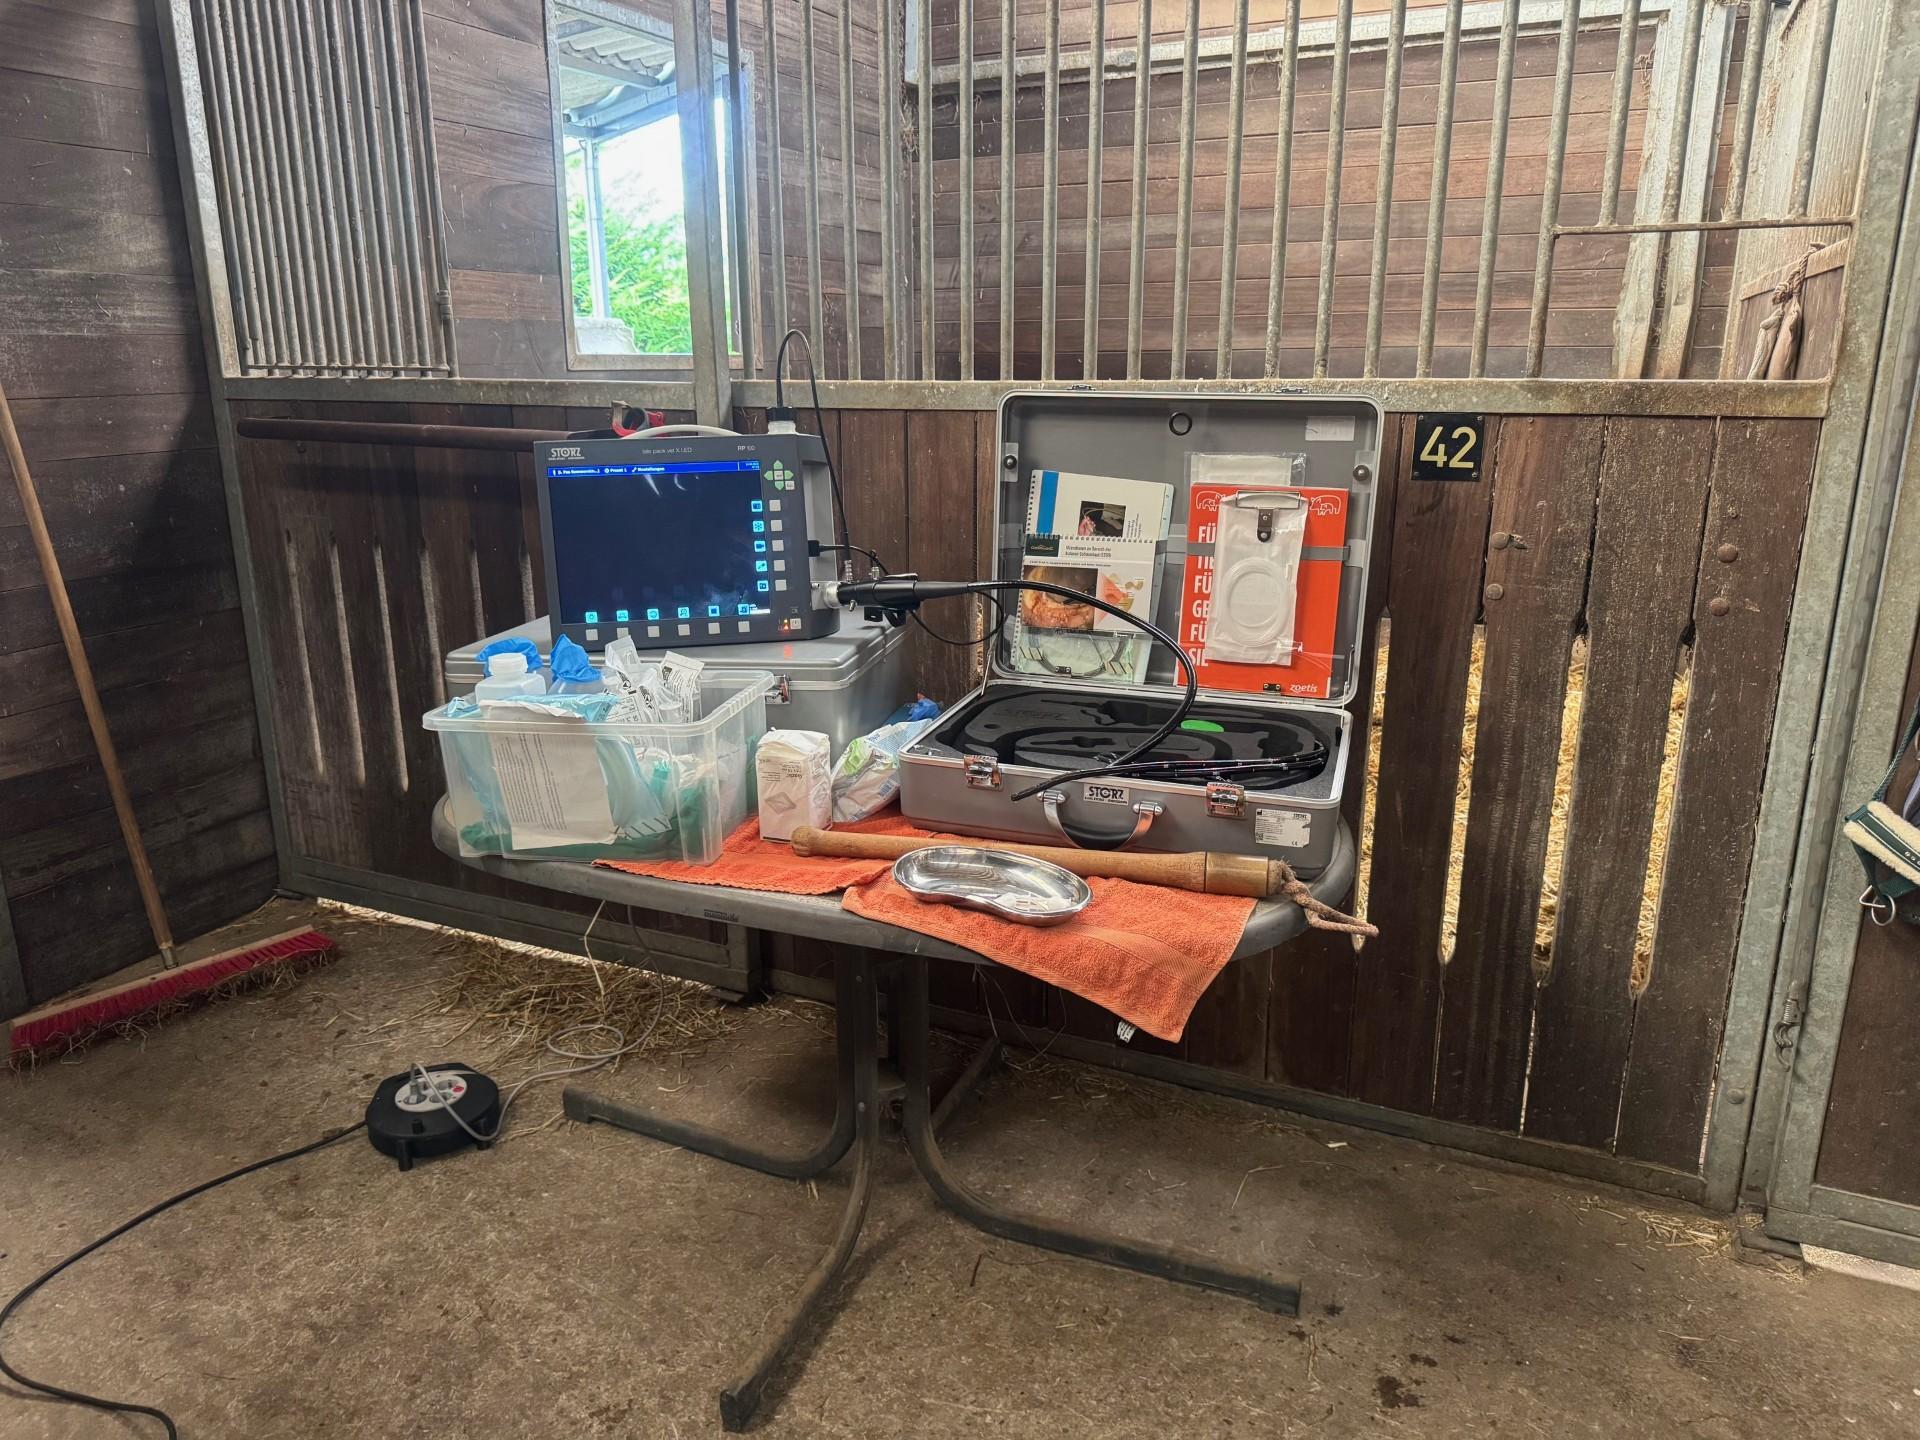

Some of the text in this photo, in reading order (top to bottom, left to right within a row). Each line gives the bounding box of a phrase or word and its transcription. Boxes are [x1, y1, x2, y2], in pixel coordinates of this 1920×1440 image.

[551, 447, 582, 458] STORZ
[1420, 426, 1476, 468] 42
[1198, 522, 1217, 544] FÜ
[1194, 572, 1212, 594] FÜ
[1190, 620, 1207, 643] FÜ
[1290, 683, 1318, 693] zoetis
[1089, 786, 1124, 800] STORZ
